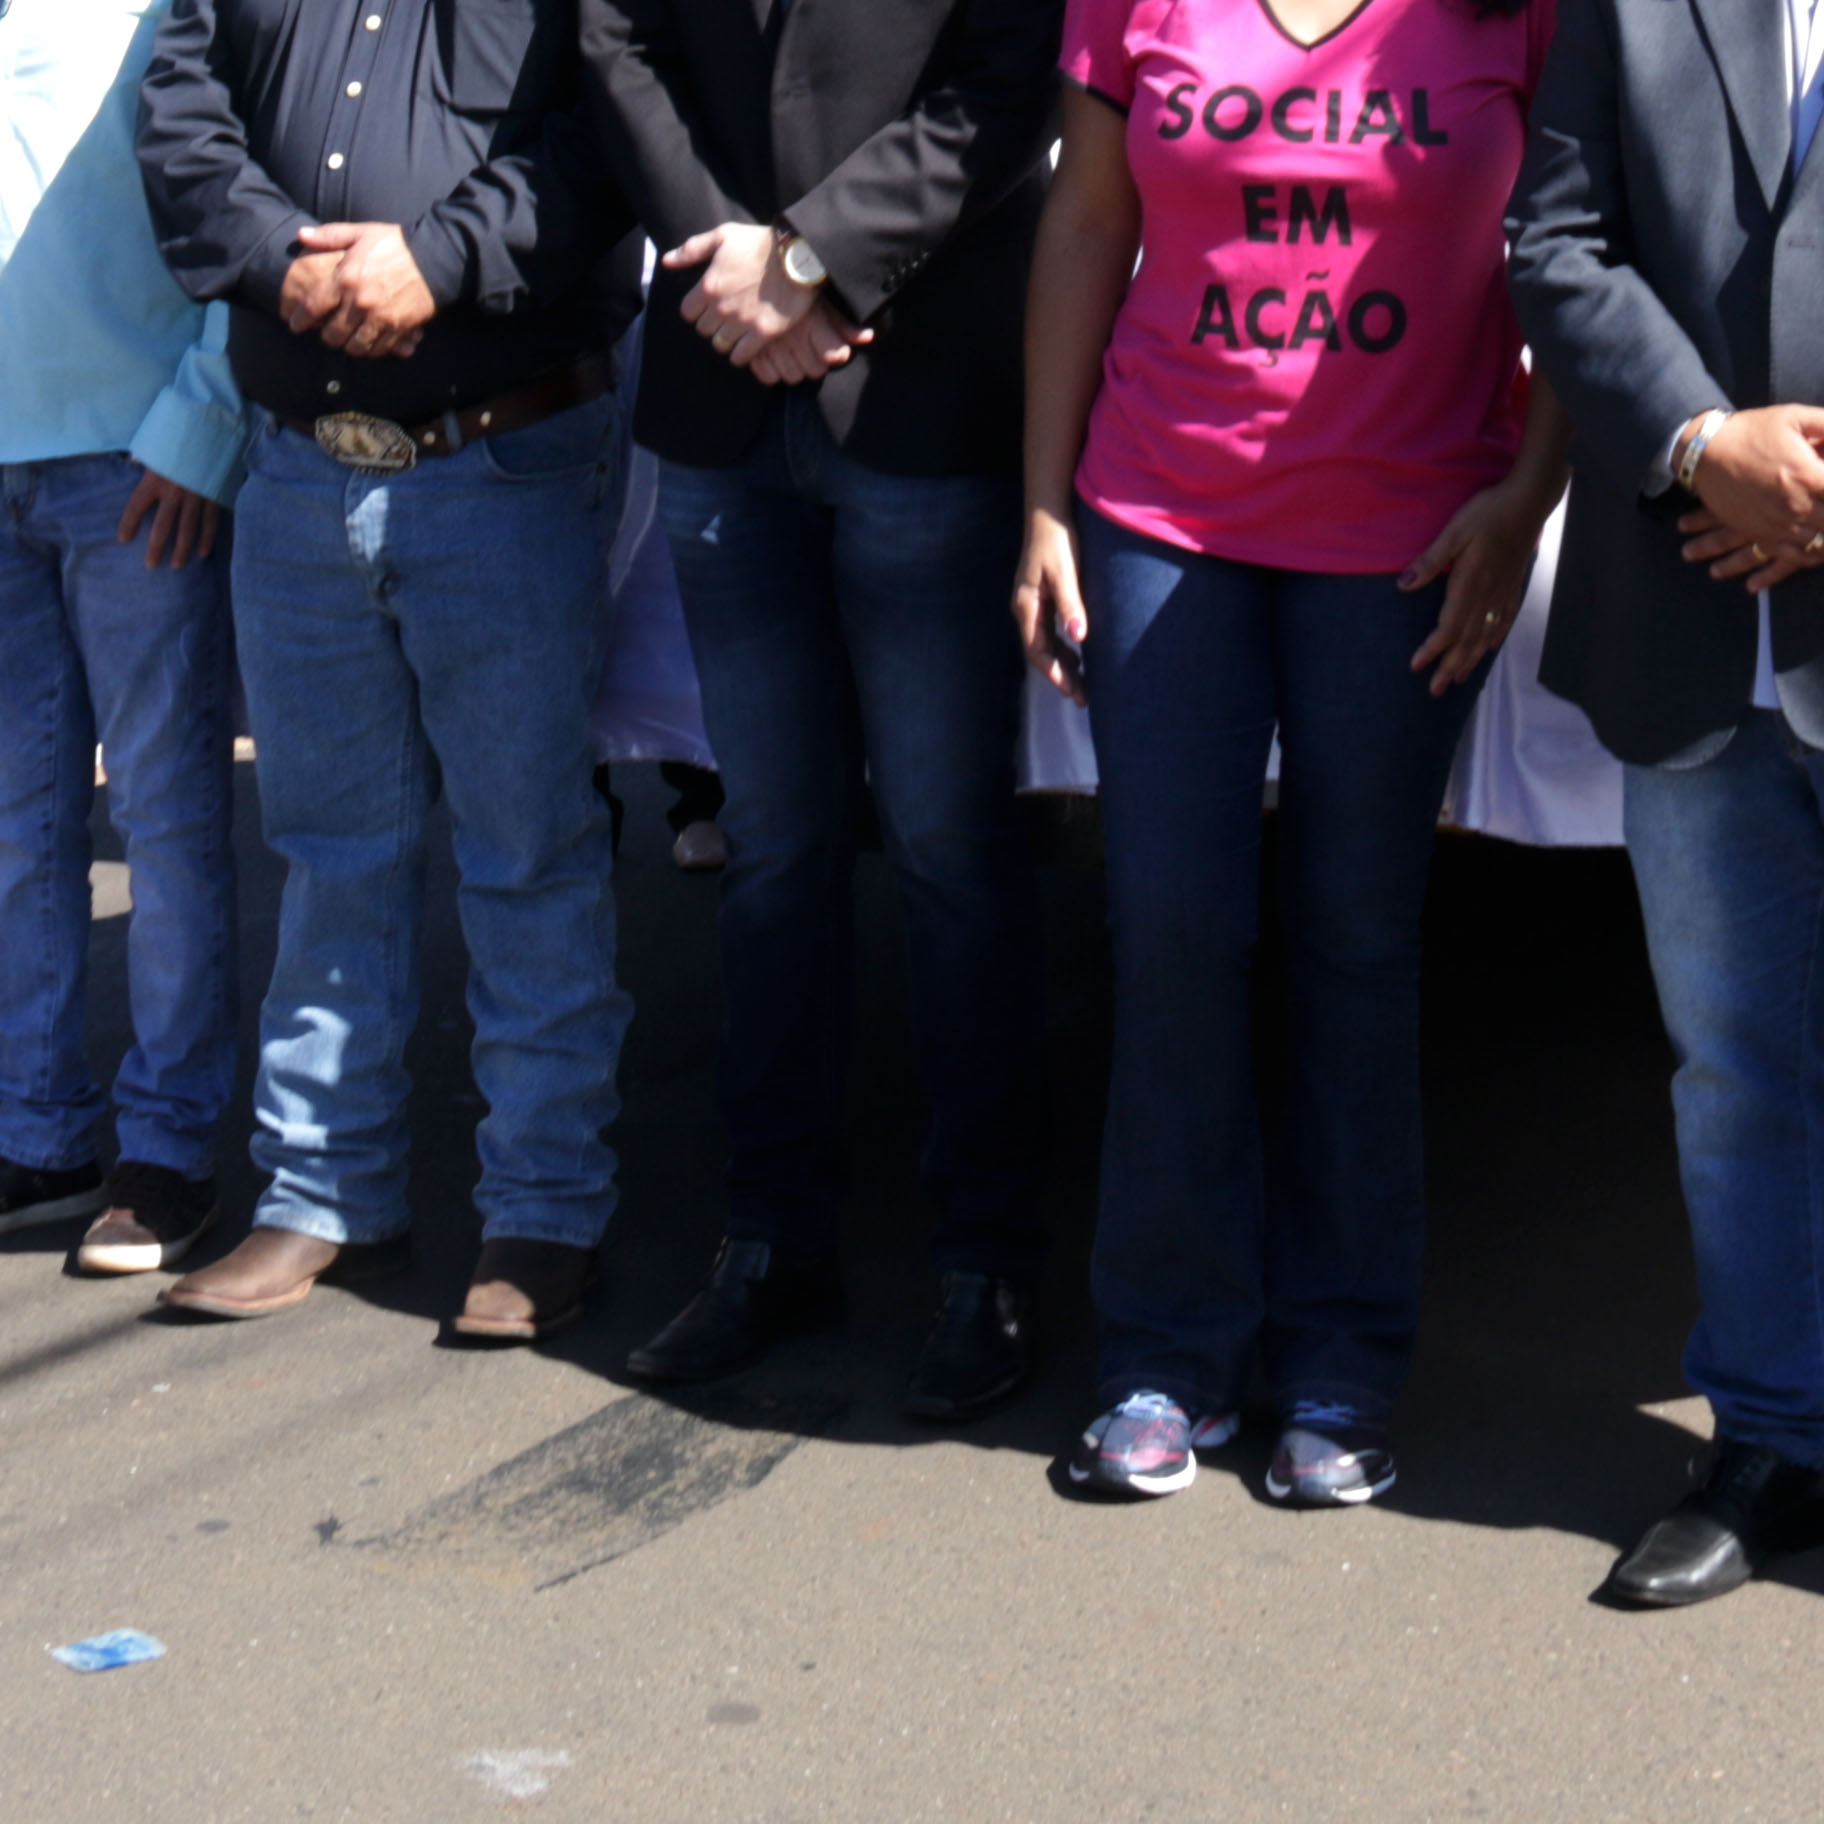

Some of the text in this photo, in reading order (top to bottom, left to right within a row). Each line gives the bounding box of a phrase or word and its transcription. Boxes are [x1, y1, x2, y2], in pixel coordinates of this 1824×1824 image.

[1157, 83, 1449, 146] SOCIAL
[1241, 184, 1353, 246] EM
[1191, 268, 1408, 368] AÇÃO
